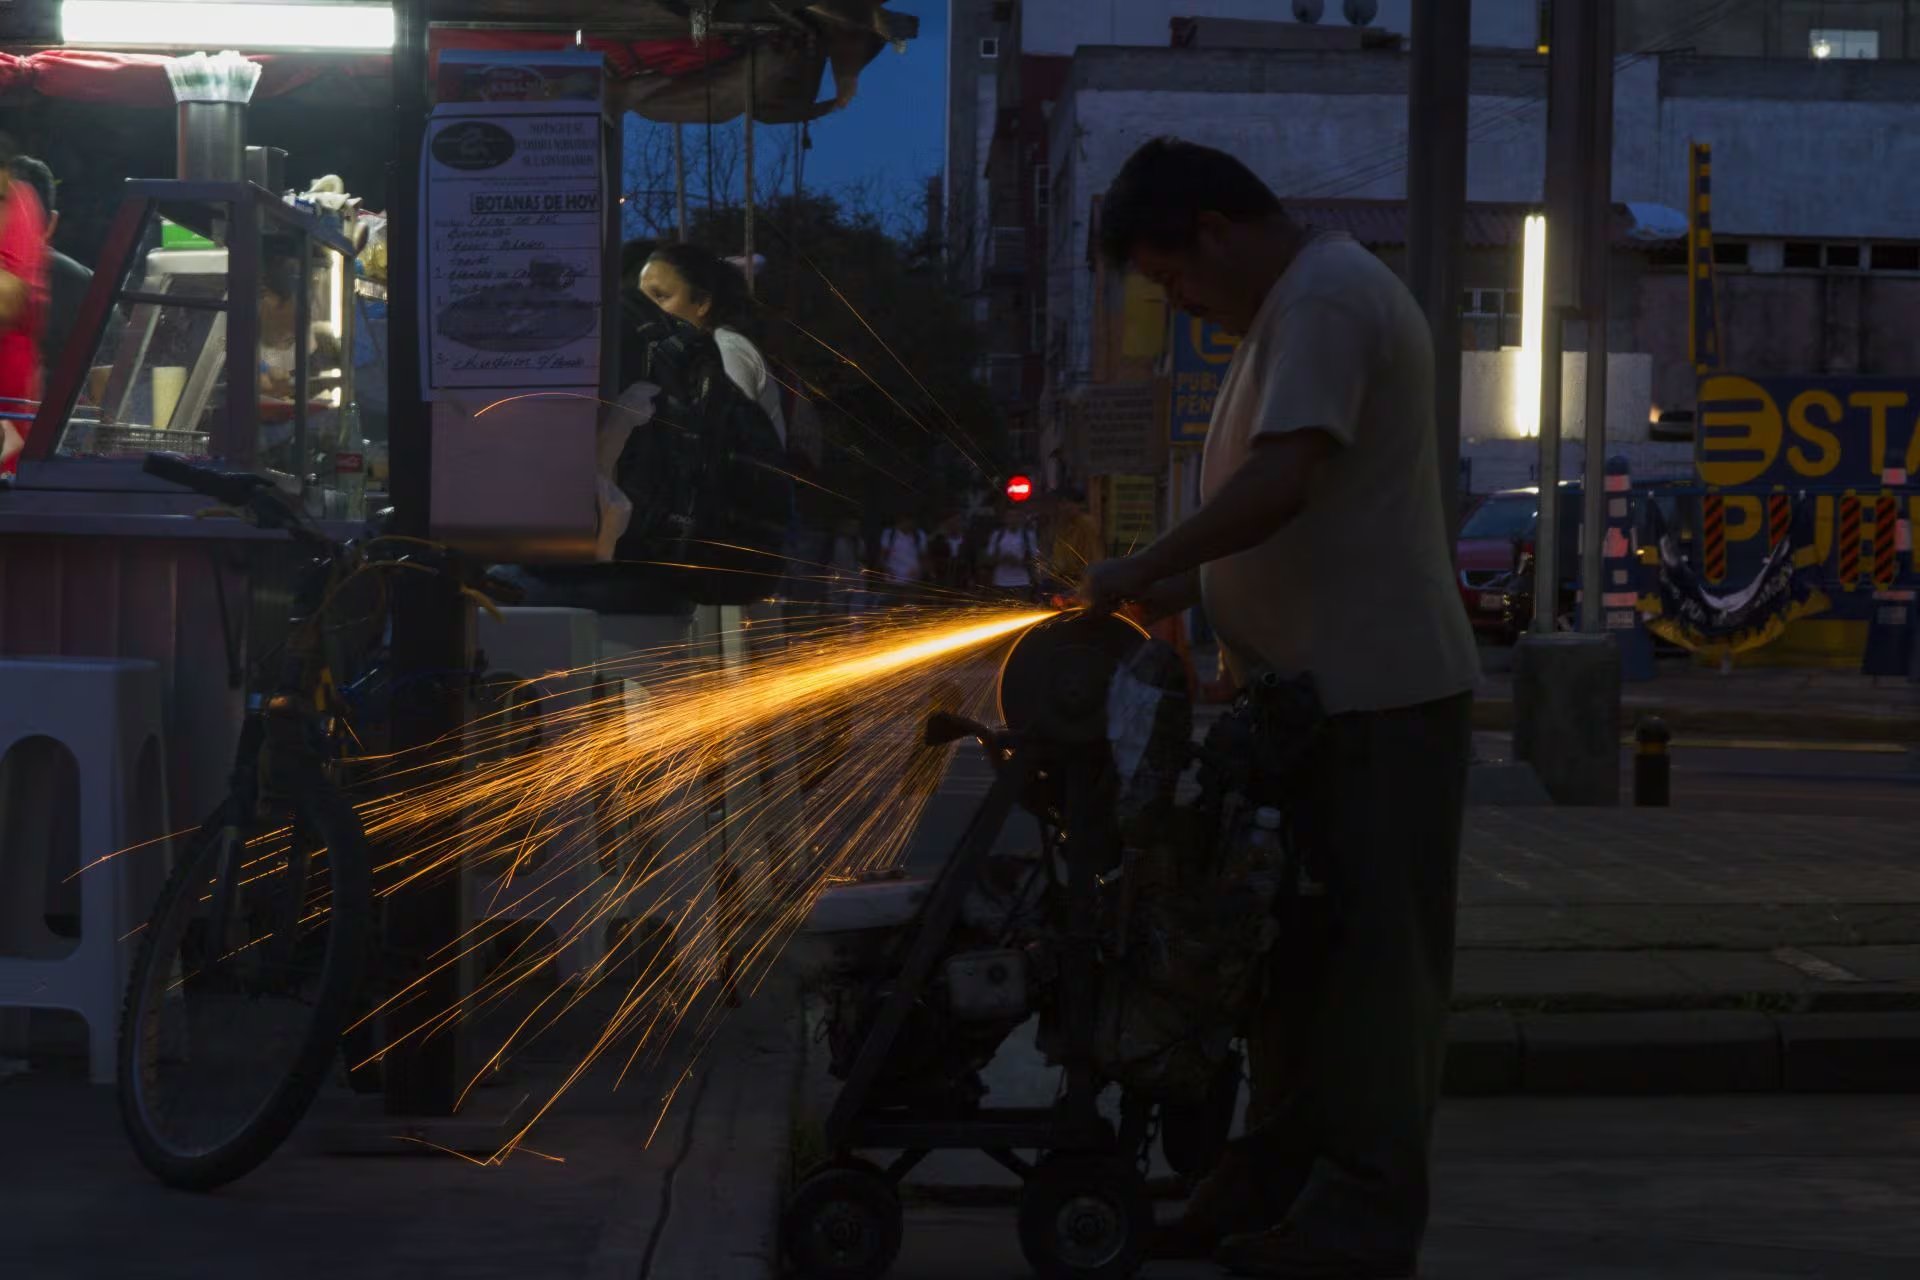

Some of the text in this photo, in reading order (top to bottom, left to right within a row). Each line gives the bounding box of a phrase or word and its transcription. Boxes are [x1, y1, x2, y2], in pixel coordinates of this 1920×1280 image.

[474, 193, 598, 212] BOTANAS DE HOY
